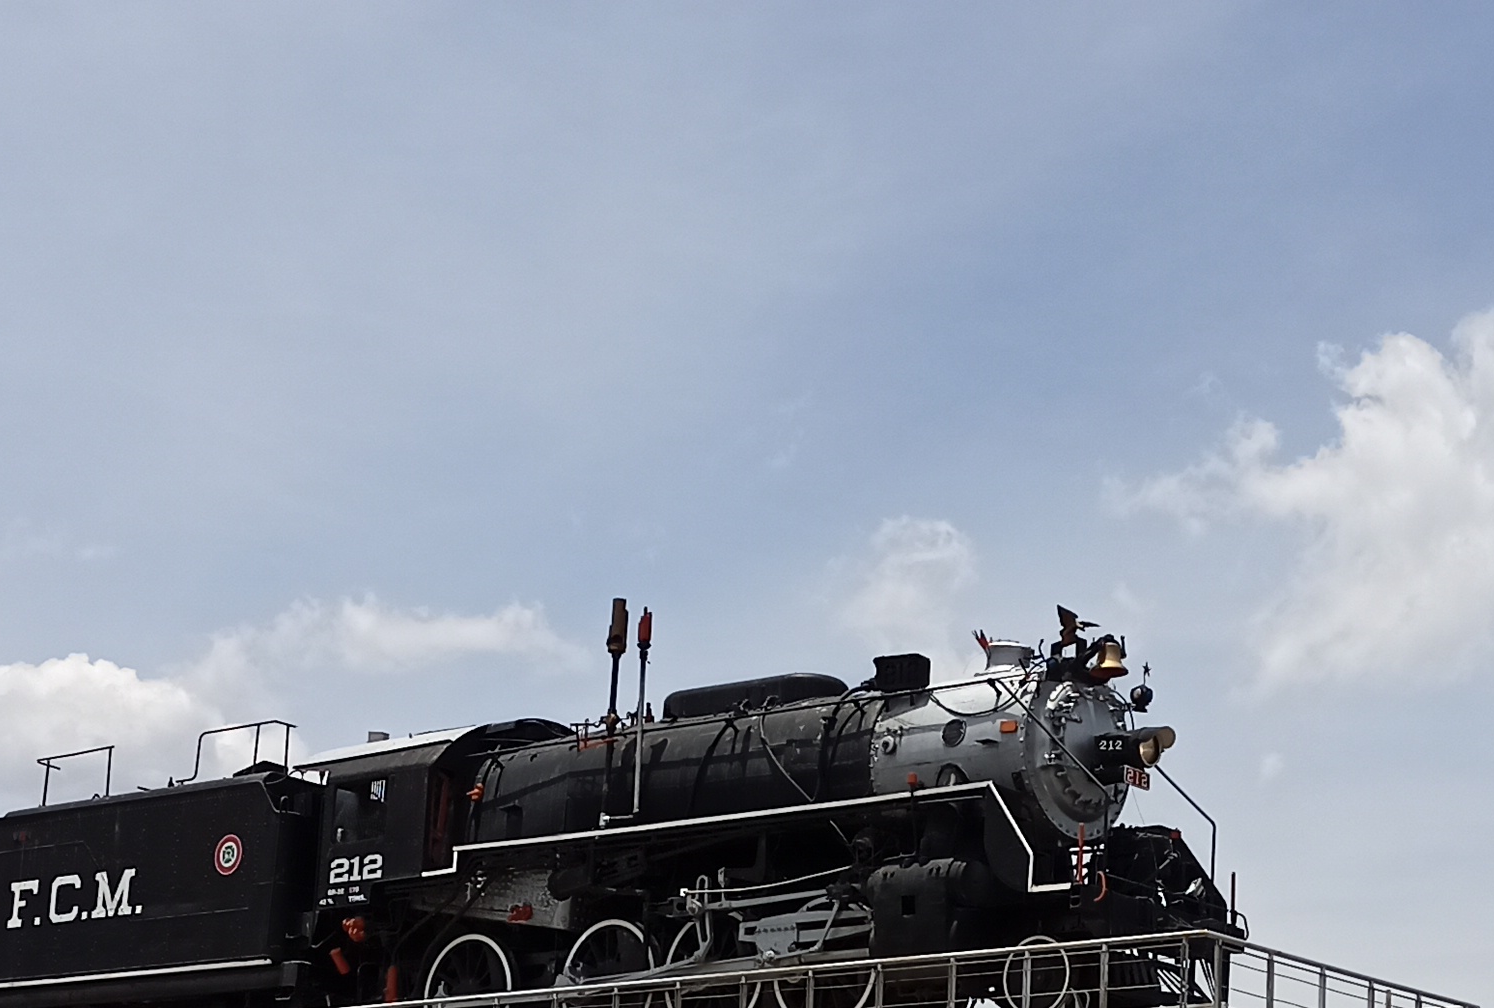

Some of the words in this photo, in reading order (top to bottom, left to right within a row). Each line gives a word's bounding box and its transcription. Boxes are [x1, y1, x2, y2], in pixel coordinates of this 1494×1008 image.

[1098, 740, 1123, 751] 212
[1126, 768, 1148, 788] 212
[329, 853, 383, 884] 212
[6, 868, 143, 929] F.C.M.
